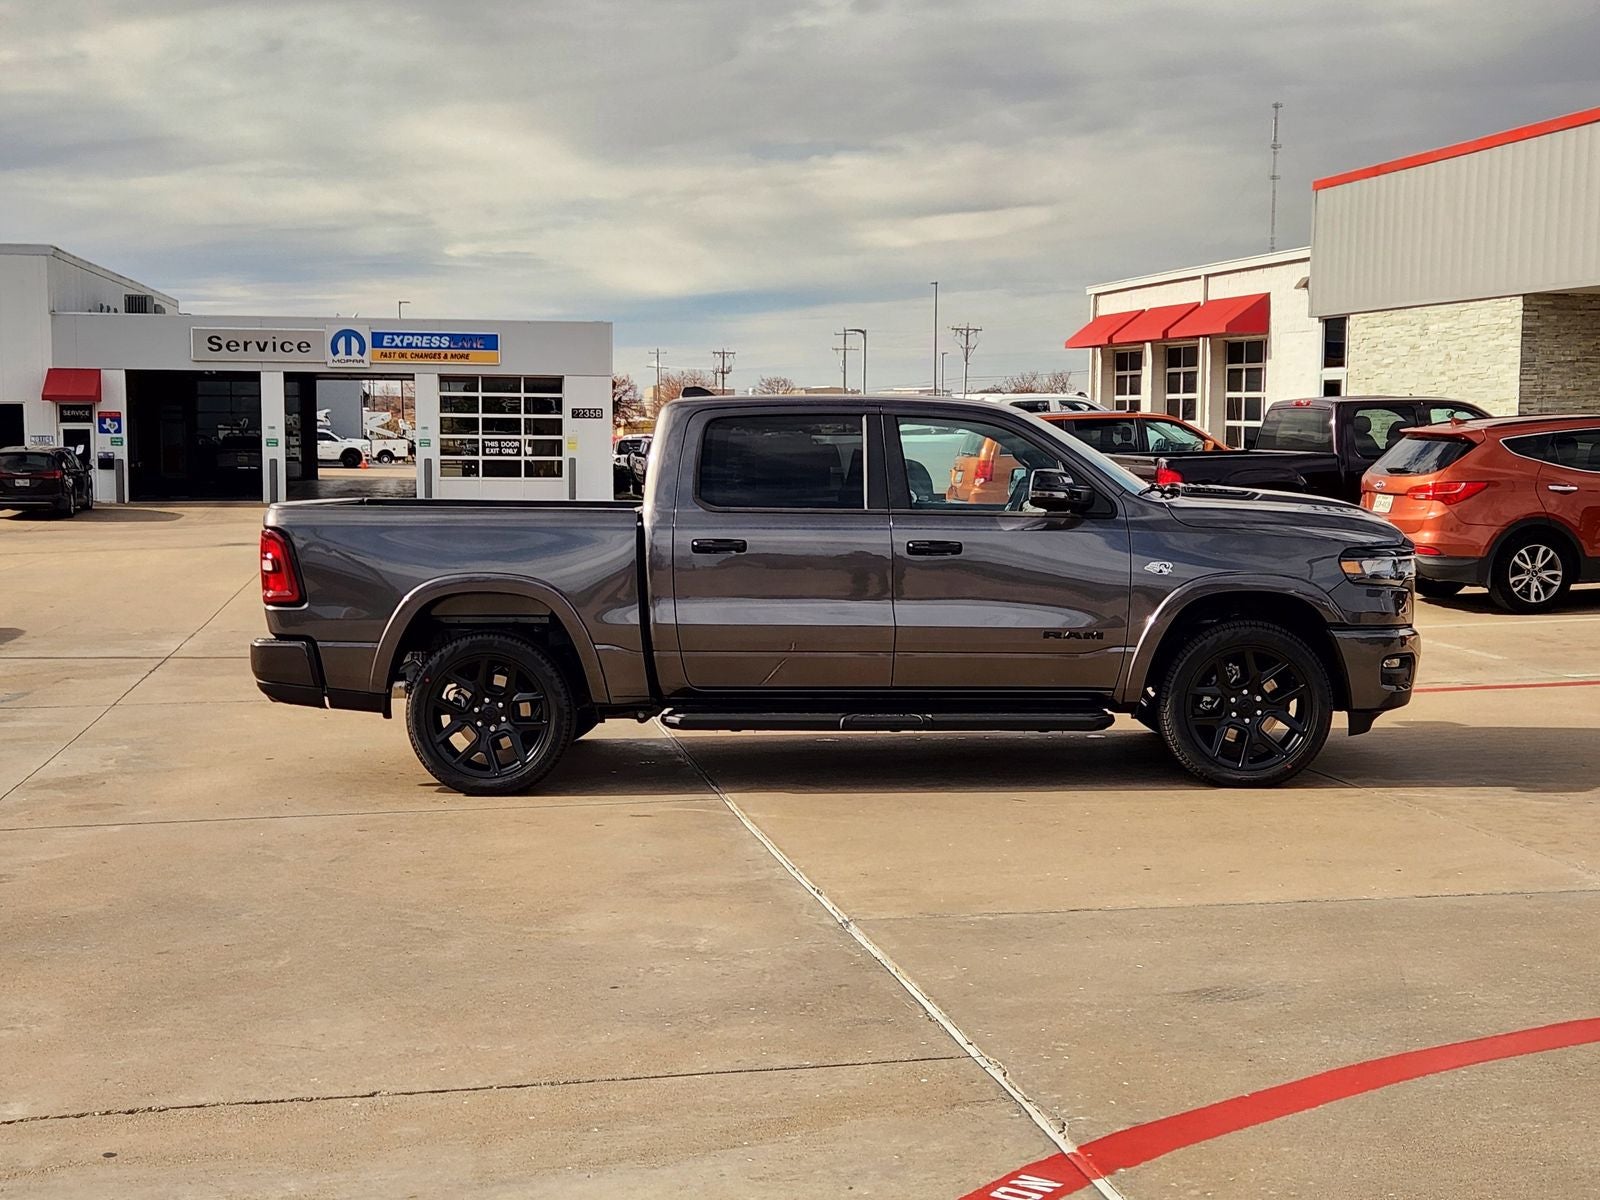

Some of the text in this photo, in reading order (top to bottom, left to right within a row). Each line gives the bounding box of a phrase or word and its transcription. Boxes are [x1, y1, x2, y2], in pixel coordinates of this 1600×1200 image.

[207, 335, 312, 353] Service
[410, 352, 442, 360] CHANGES
[573, 409, 602, 418] 2235B
[1043, 630, 1104, 640] RAM
